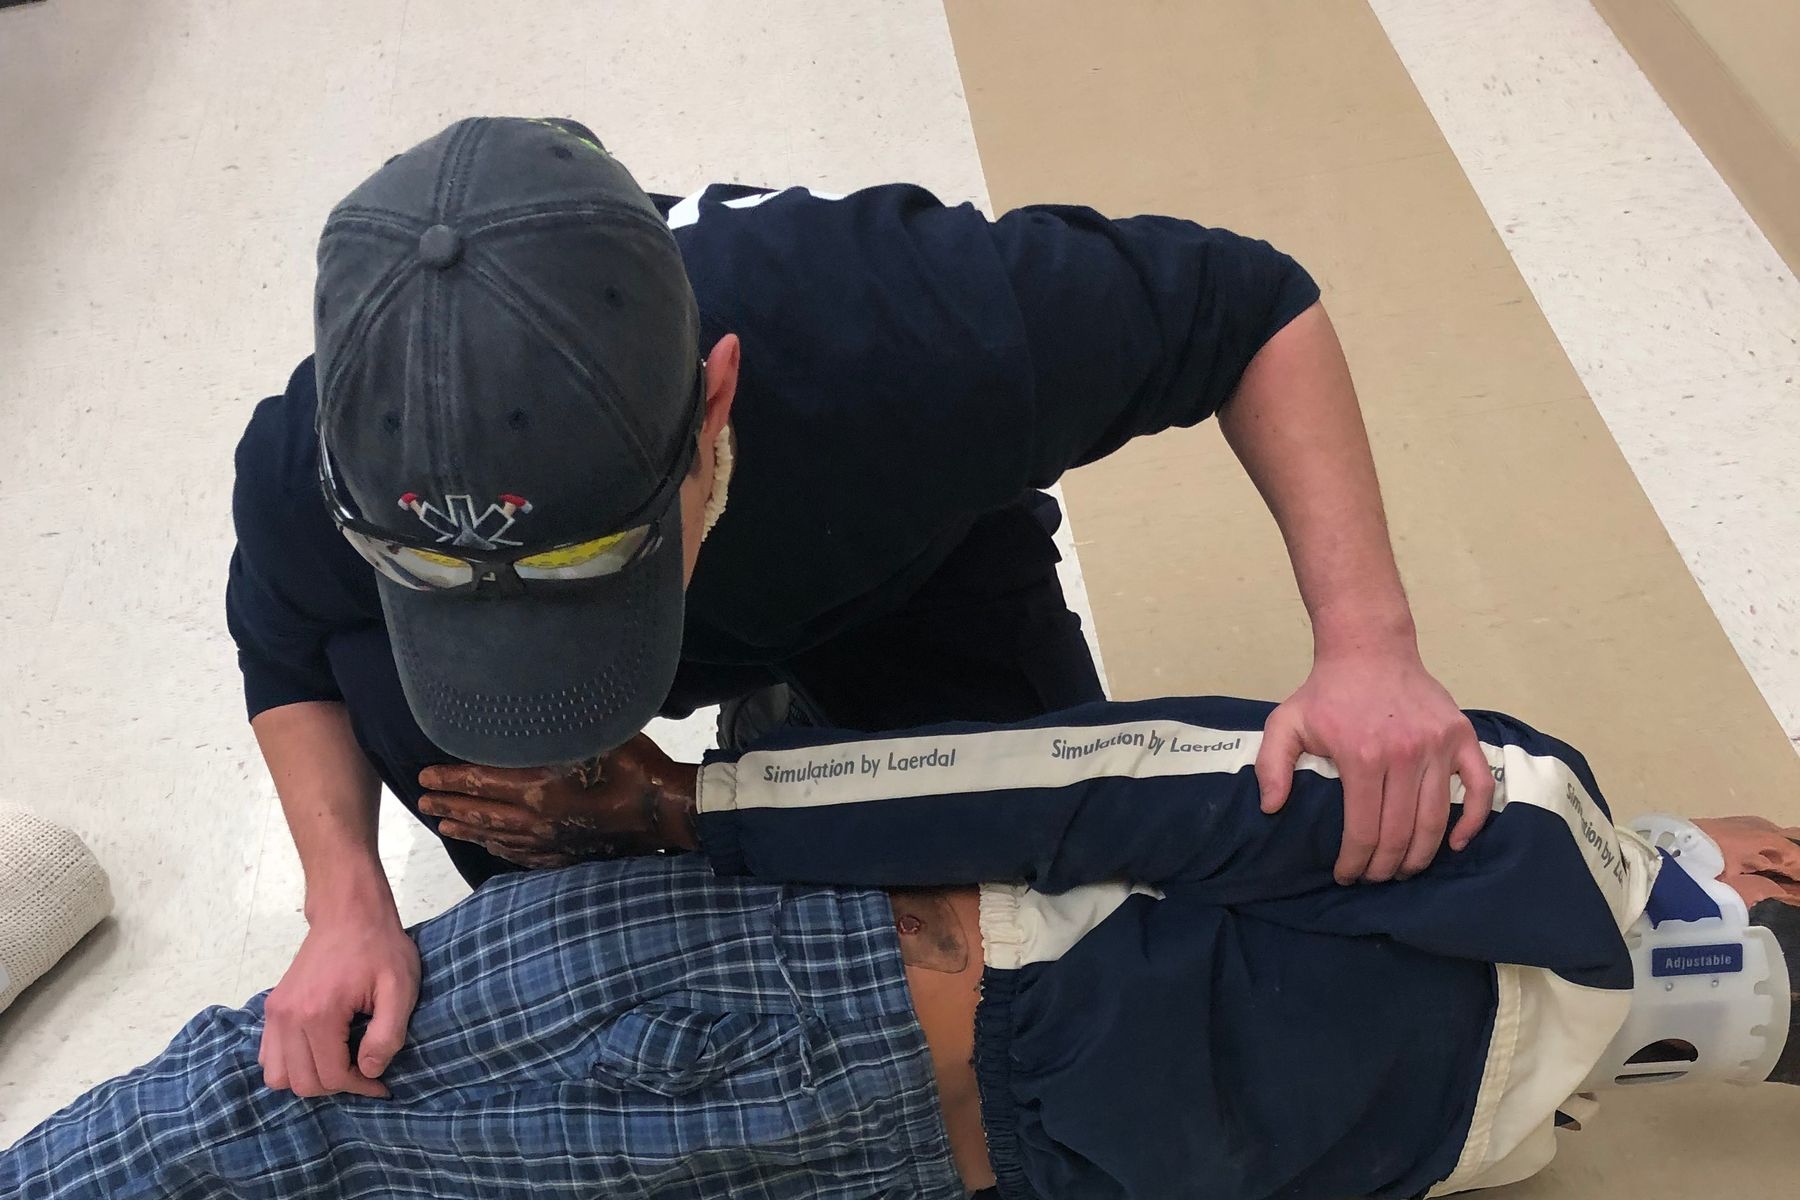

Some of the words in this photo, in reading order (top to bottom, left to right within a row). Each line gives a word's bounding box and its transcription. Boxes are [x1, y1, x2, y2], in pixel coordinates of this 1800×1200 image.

[1051, 731, 1144, 760] Simulation
[1148, 730, 1165, 756] by
[1170, 737, 1241, 753] Laerdal
[763, 759, 854, 783] Simulation
[861, 754, 880, 778] by
[888, 748, 956, 771] Laerdal
[1601, 841, 1615, 868] by
[1665, 954, 1732, 969] Adjustable
